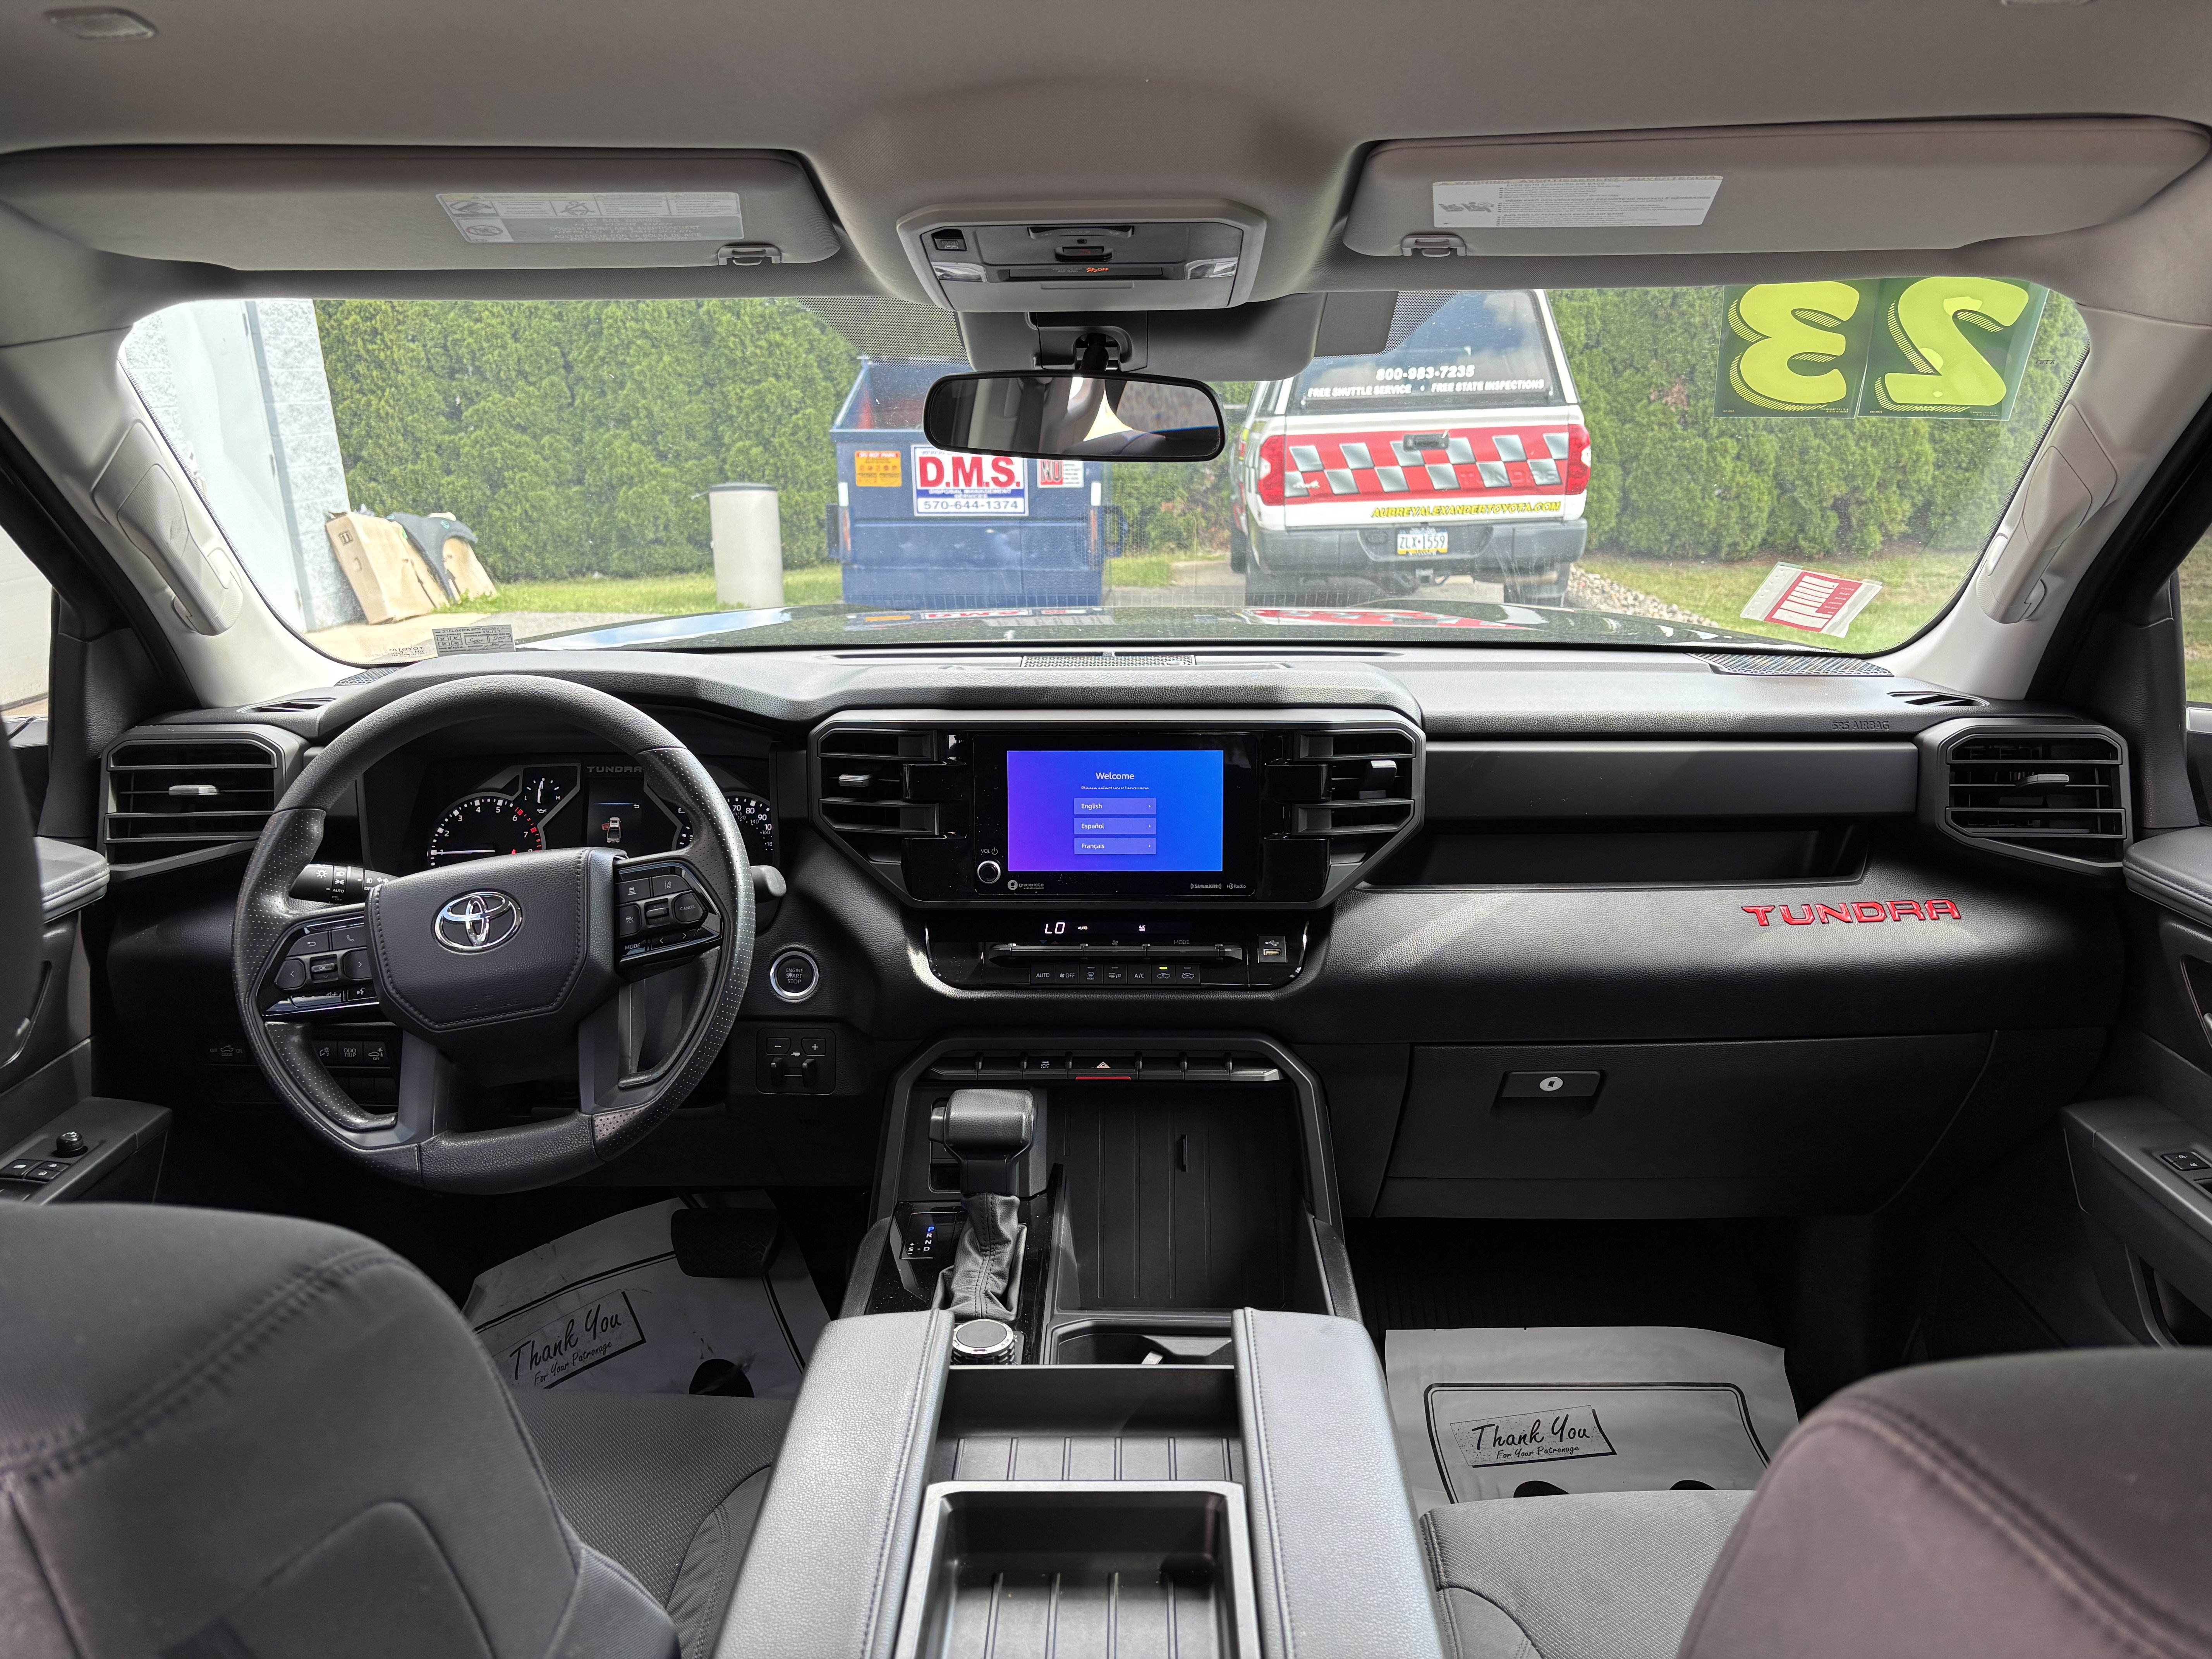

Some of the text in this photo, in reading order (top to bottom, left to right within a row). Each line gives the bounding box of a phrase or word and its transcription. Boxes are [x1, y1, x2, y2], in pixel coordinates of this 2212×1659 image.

[1308, 388, 1331, 397] FREE
[1431, 383, 1454, 393] FREE
[919, 456, 1020, 488] D.M.S.
[924, 501, 1018, 510] 570-644-1374
[1832, 721, 1889, 731] SRS AIRBAG
[1741, 899, 1961, 927] TUNDRA
[1044, 922, 1066, 934] LO
[509, 1304, 622, 1381] Thank You
[533, 1340, 613, 1386] For Your Patronage
[1472, 1414, 1590, 1451] Thank You
[1496, 1445, 1580, 1459] For Your Patronage
